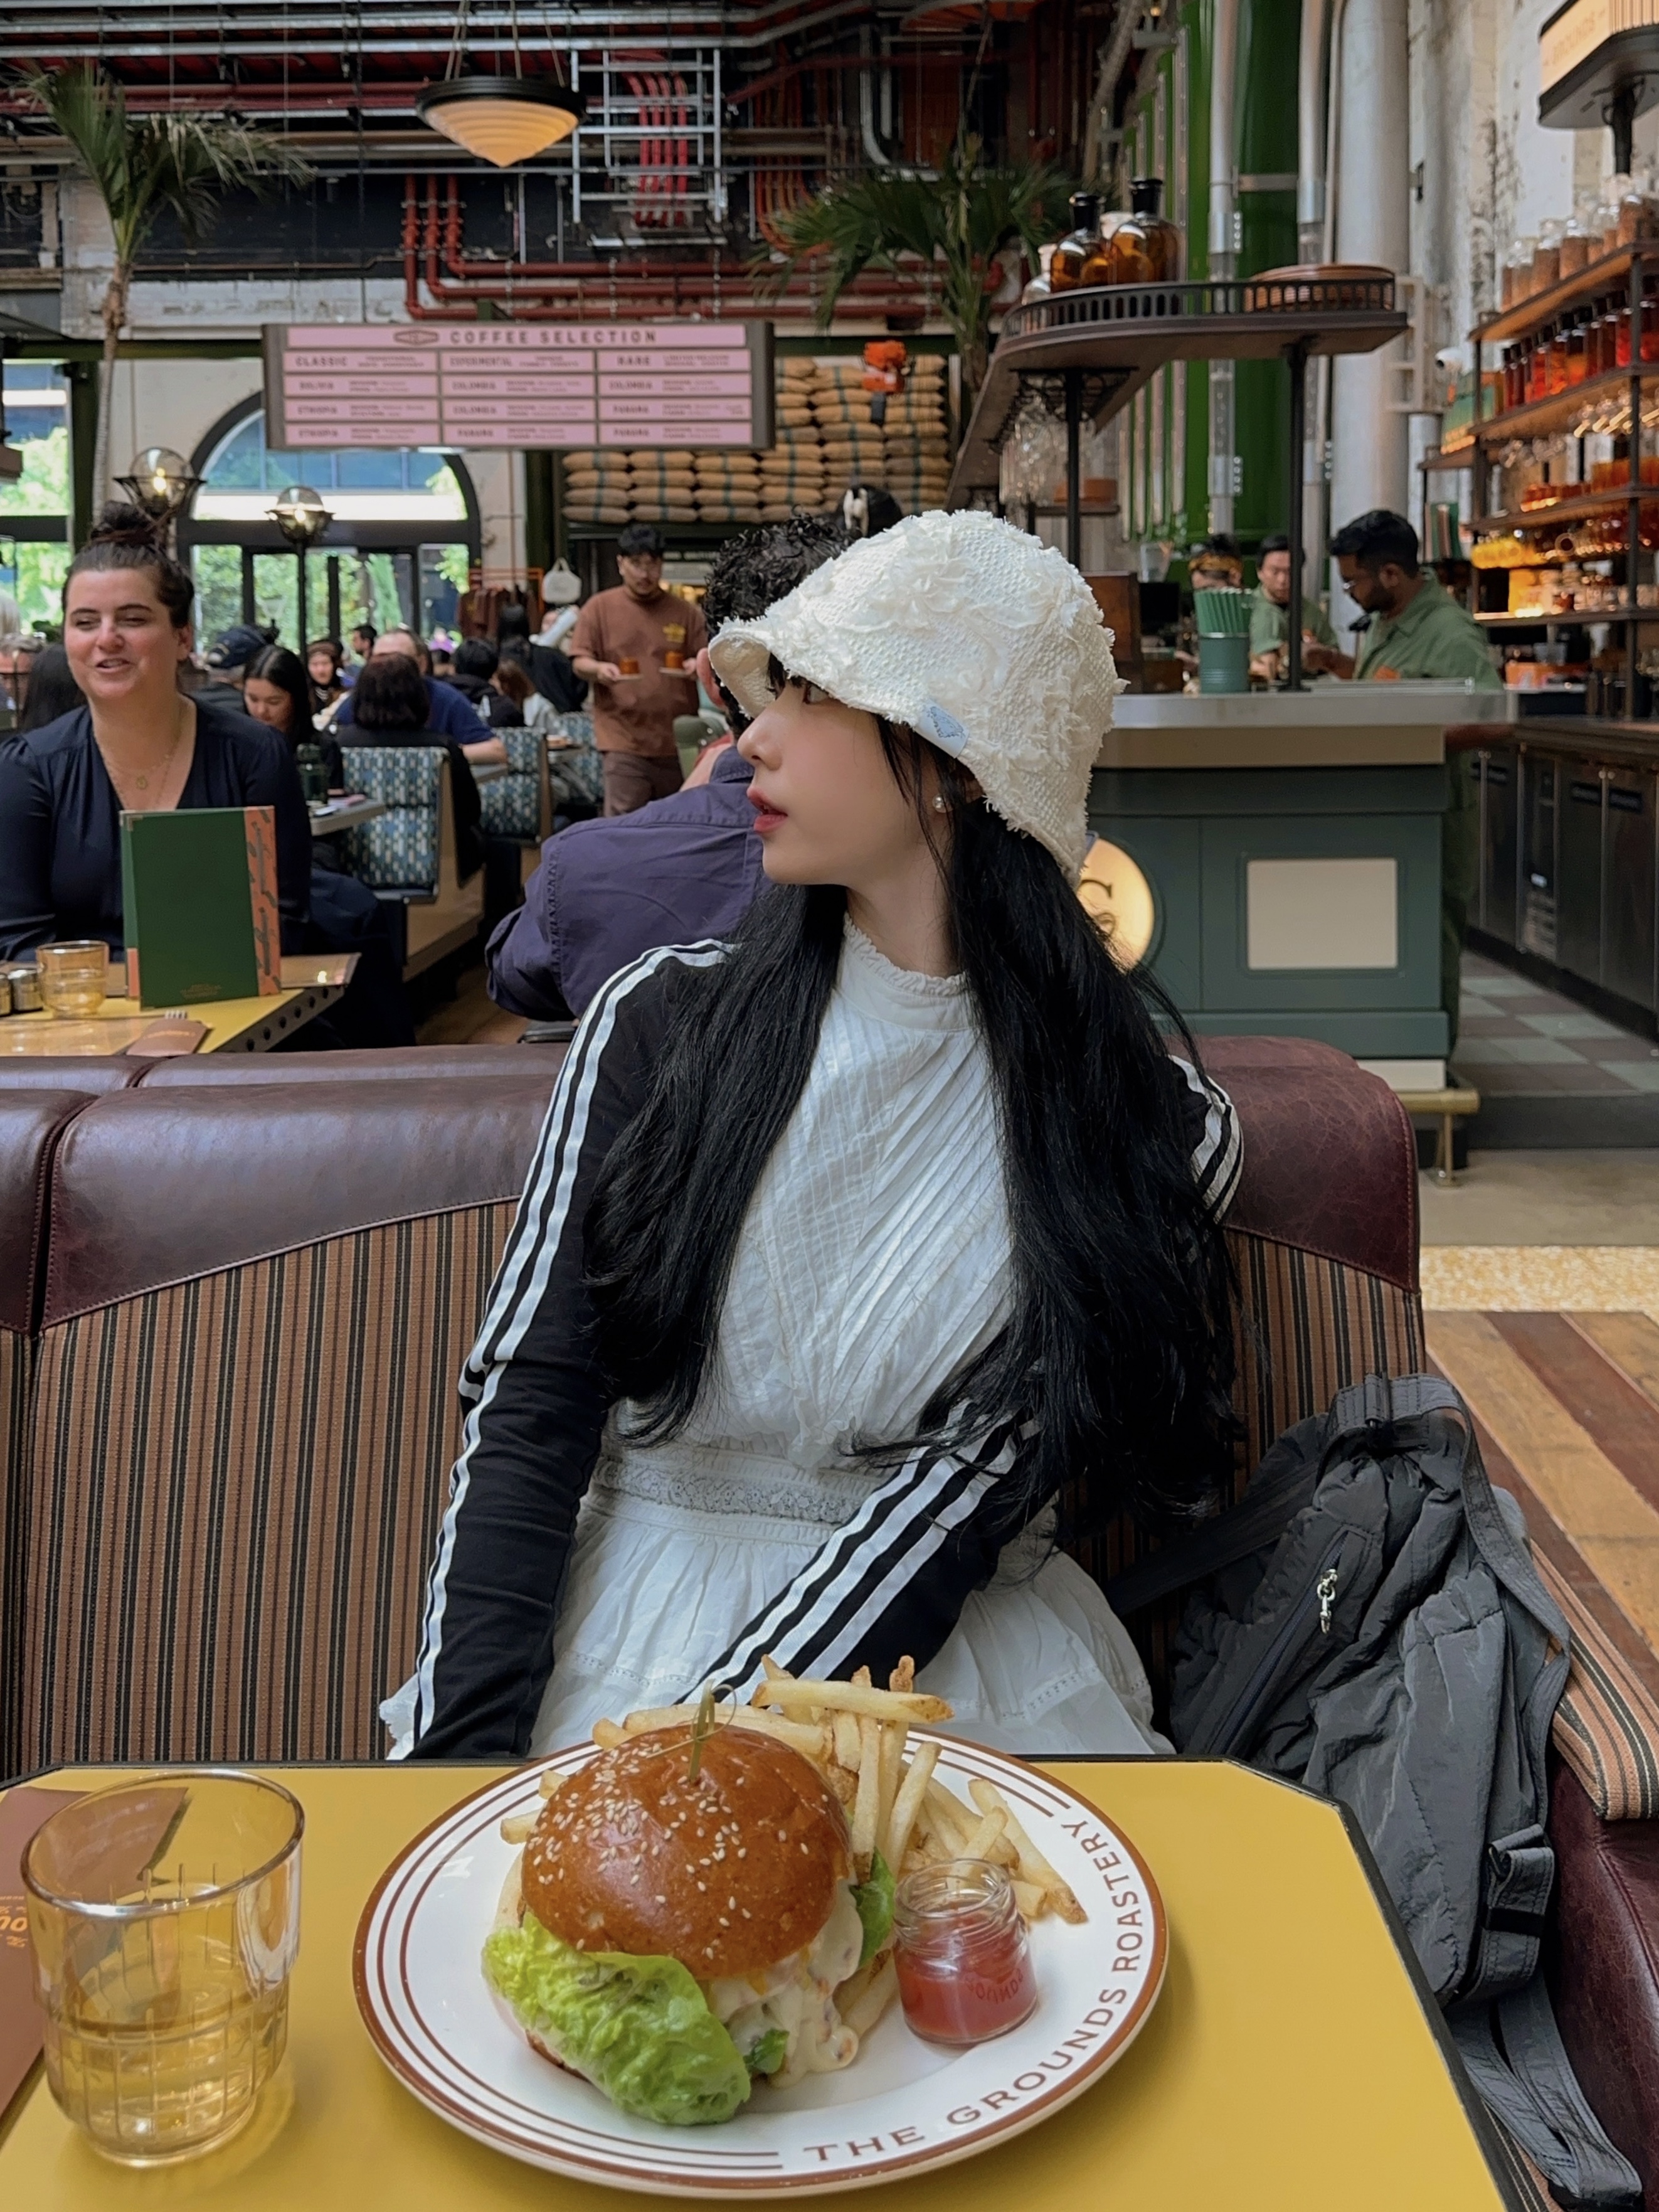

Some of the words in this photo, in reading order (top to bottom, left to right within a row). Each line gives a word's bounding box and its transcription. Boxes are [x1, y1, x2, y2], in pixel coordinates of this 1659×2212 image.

[450, 331, 528, 344] COFFEE
[539, 330, 657, 344] SELECTION
[295, 356, 347, 367] CLASSIC
[450, 356, 512, 367] EXPERIMENTAL
[617, 356, 650, 366] RARE
[803, 2126, 925, 2161] THE
[946, 1988, 1127, 2125] GROUNDS
[1061, 1820, 1143, 1972] ROASTERY
